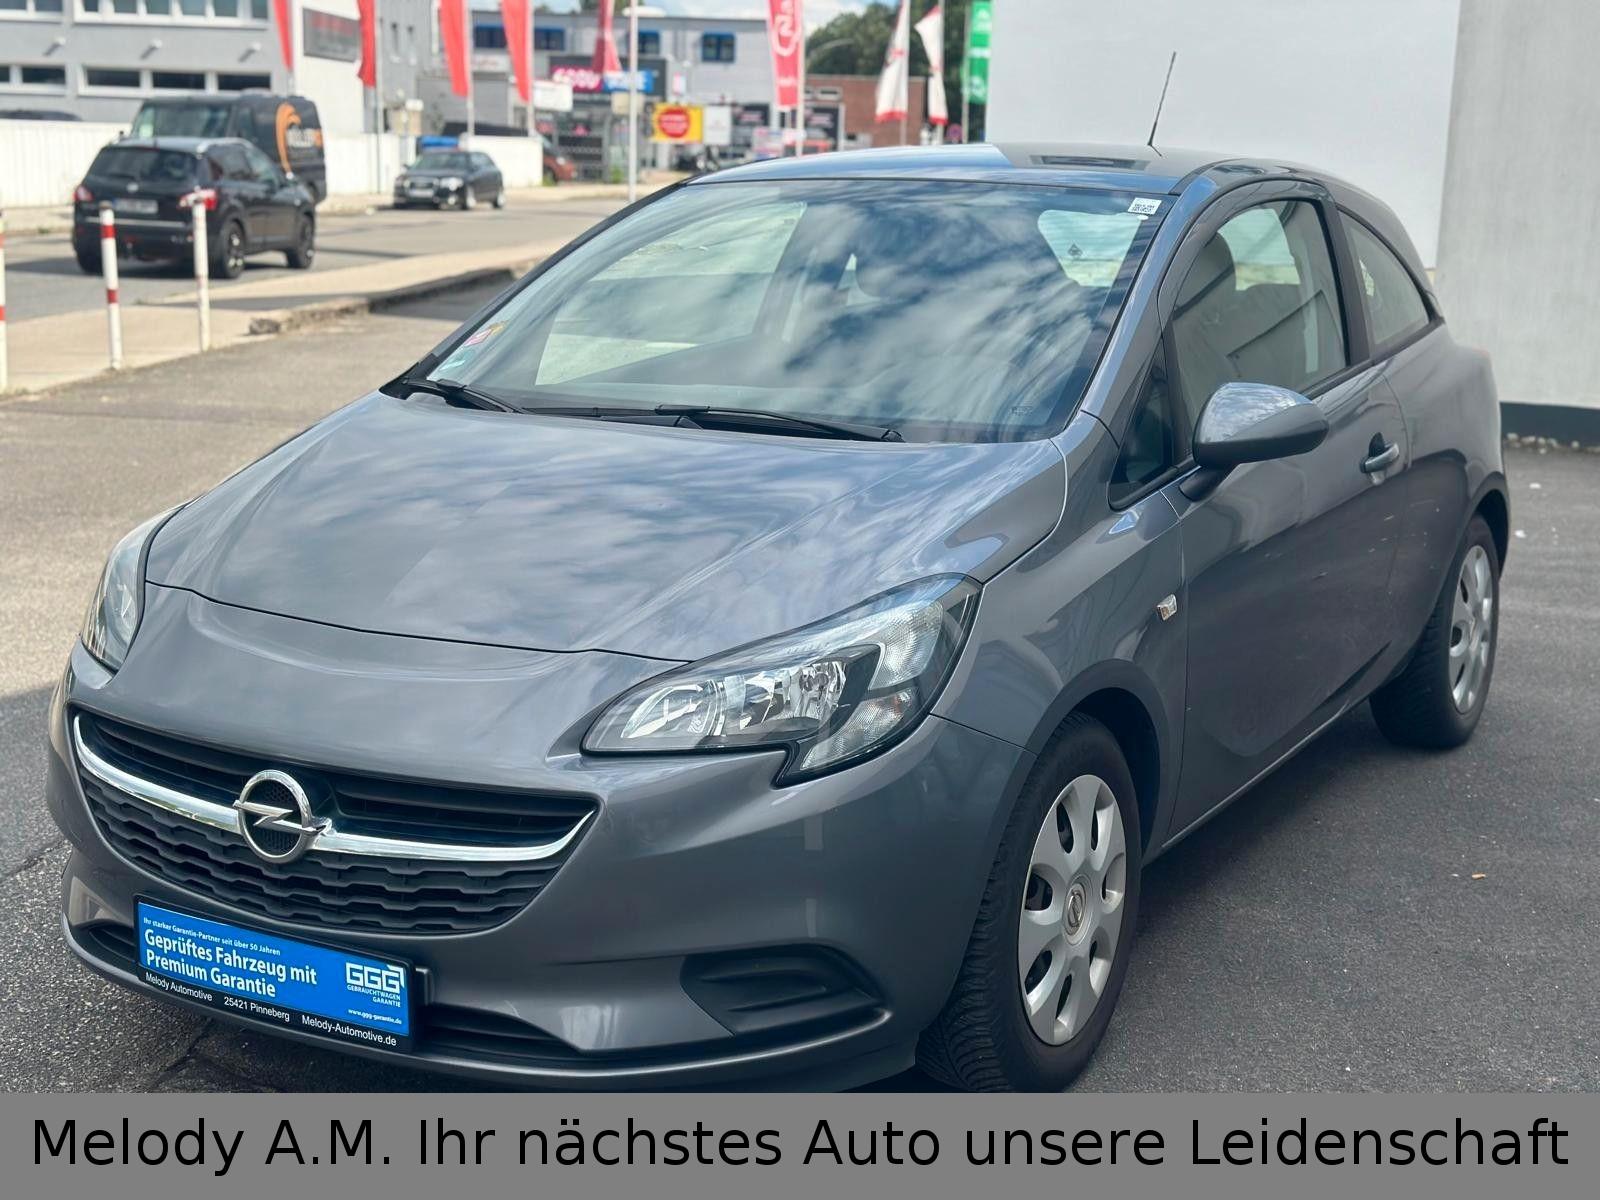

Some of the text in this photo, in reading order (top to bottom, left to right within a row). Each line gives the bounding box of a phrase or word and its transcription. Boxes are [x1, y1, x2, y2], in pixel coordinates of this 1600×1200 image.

[143, 917, 281, 956] Ihr starker Garantie-Partner seit über 50 Jahren
[144, 929, 317, 985] Geprüftes Fahrzeug mit
[146, 949, 276, 998] Premium Garantie
[345, 962, 401, 994] GGG
[346, 984, 401, 1001] GEBRAUCHTWAGEN
[145, 972, 397, 1046] Melody Automotive 25421 Pinneberg Melody-Automotive.de
[347, 1009, 402, 1025] www.ggg-garantie.de
[372, 996, 401, 1008] GARANTIE
